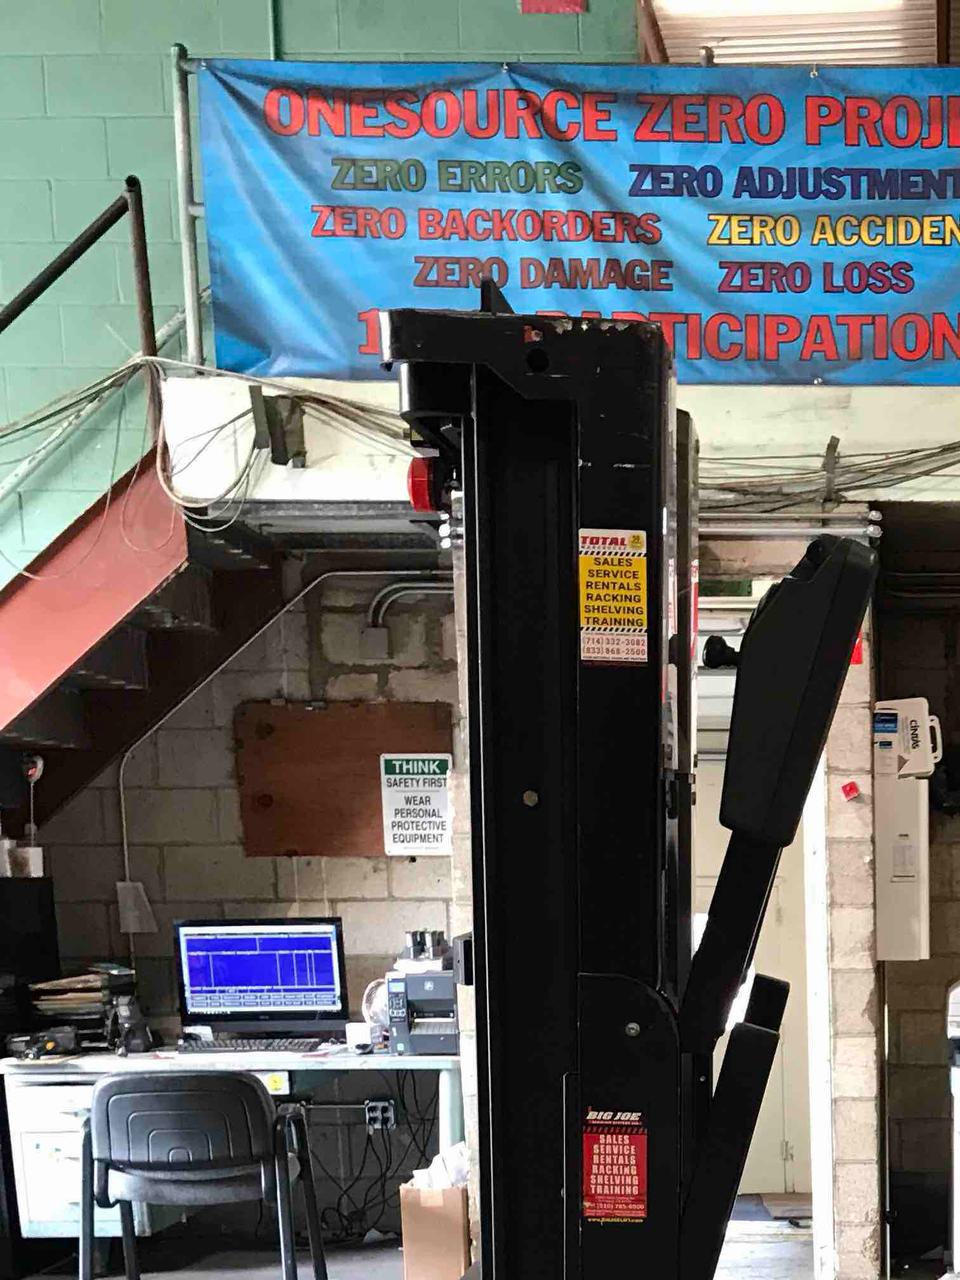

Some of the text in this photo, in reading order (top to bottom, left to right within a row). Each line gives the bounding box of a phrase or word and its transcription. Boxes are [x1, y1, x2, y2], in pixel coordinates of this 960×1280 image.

[263, 87, 618, 142] ONESOURCE
[634, 93, 786, 145] ZERO
[331, 158, 583, 195] ZERO ERRORS
[629, 164, 724, 198] ZERO
[311, 205, 662, 244] ZERO BACKORDERS
[707, 214, 800, 246] ZERO
[413, 255, 674, 292] ZERO DAMAGE
[718, 261, 915, 295] ZERO LOSS
[581, 535, 627, 546] TOTAL
[594, 557, 633, 567] SALES
[588, 569, 639, 579] SERVICE
[586, 581, 641, 591] RENTALS
[587, 593, 641, 603] RACKING
[584, 605, 644, 615] SHELVING
[584, 616, 644, 627] TRAINING
[392, 761, 440, 774] THINK
[386, 778, 447, 788] SAFETY FIRST
[404, 796, 431, 806] WEAR
[394, 808, 442, 818] PERSONAL
[391, 821, 447, 831] PROTECTIVE
[392, 833, 444, 843] EQUIPMENT
[586, 1111, 642, 1121] BIG JOE
[600, 1134, 629, 1144] SALES
[593, 1144, 636, 1155] SERVICE
[593, 1155, 636, 1165] RENTALS
[592, 1165, 637, 1175] RACKING
[590, 1175, 639, 1185] SHELVING
[590, 1185, 639, 1195] TRAINING
